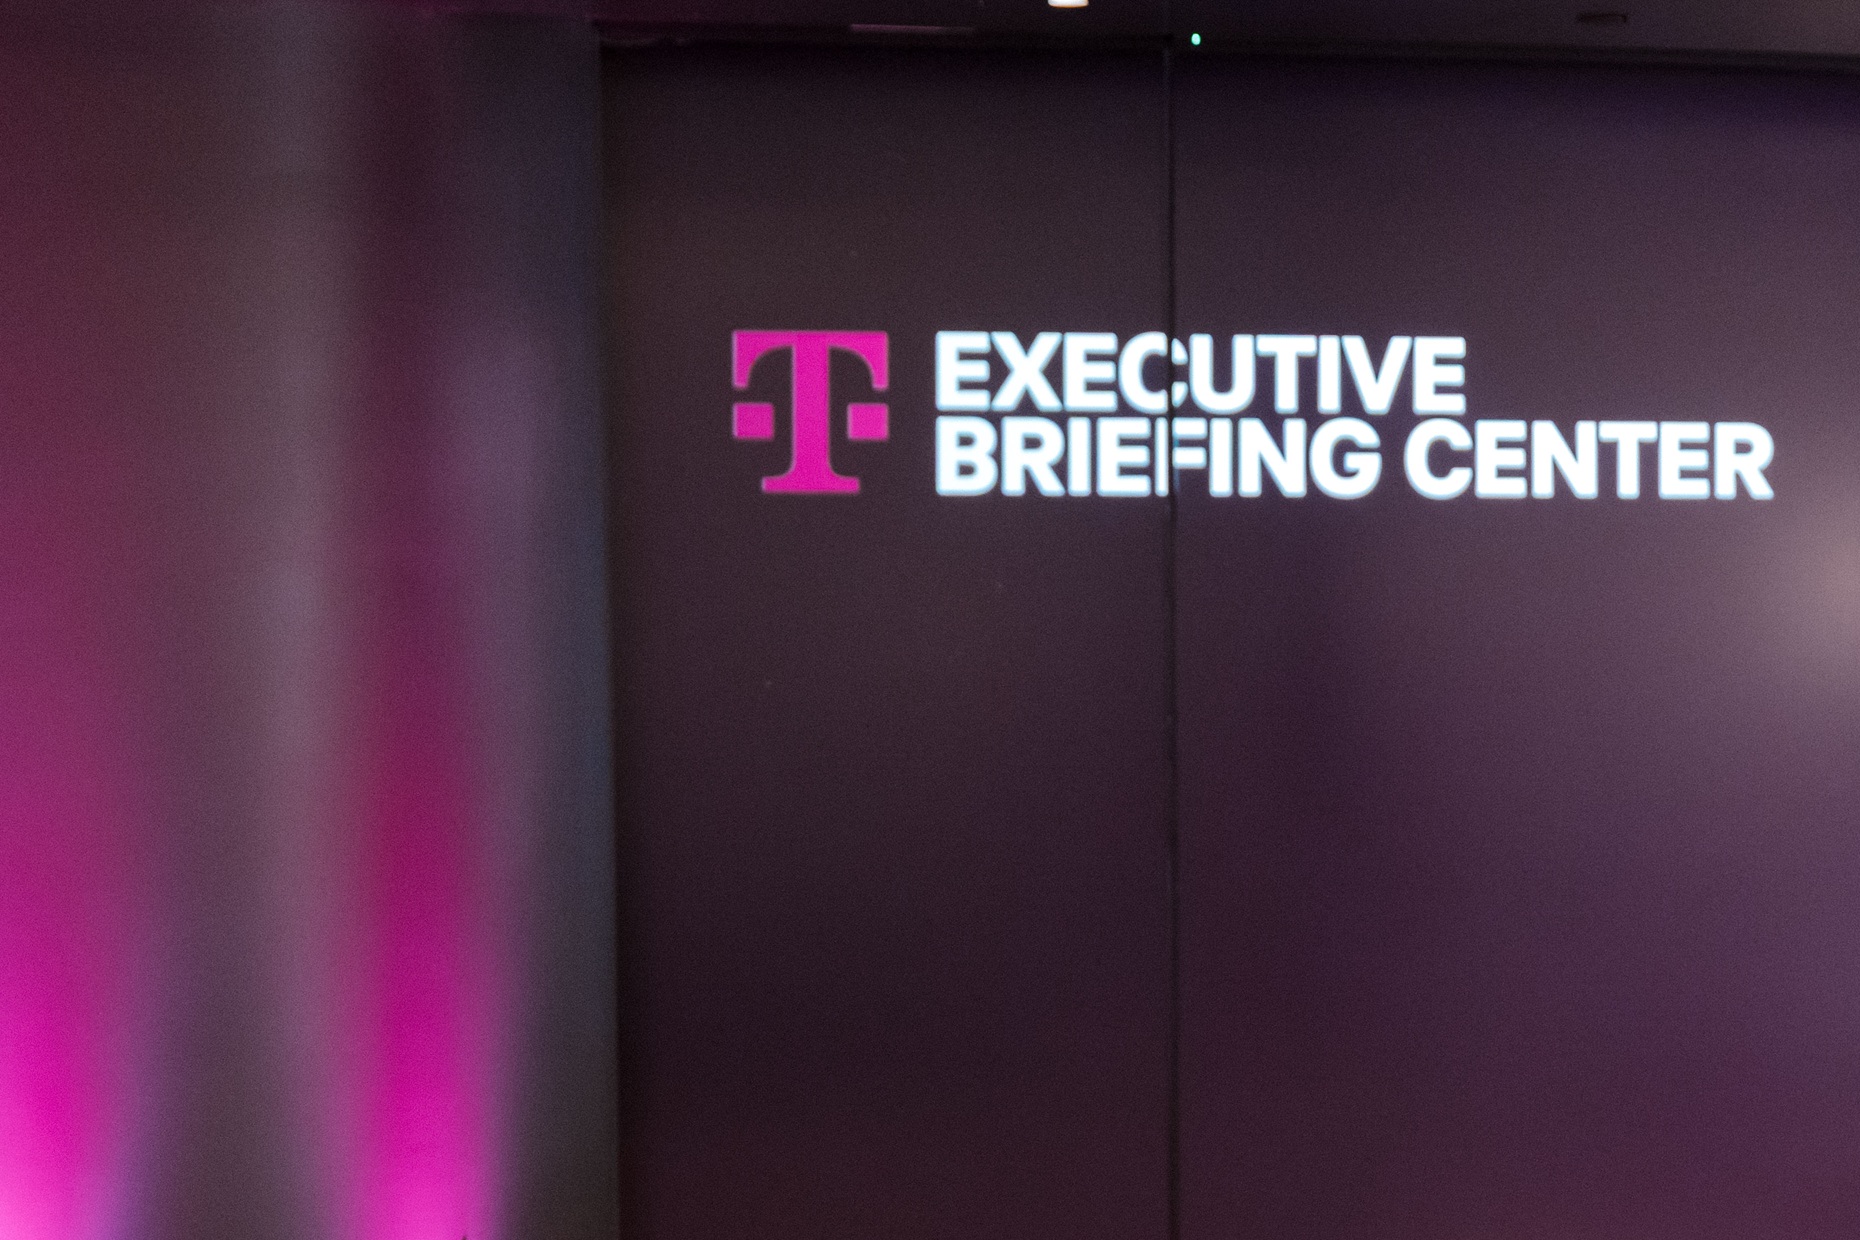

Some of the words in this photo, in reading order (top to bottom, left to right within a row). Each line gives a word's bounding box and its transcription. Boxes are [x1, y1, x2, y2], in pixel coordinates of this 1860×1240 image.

[732, 330, 889, 493] T
[935, 330, 1466, 414] EXECUTIVE
[935, 415, 1382, 499] BRIEFING
[1404, 418, 1775, 500] CENTER
